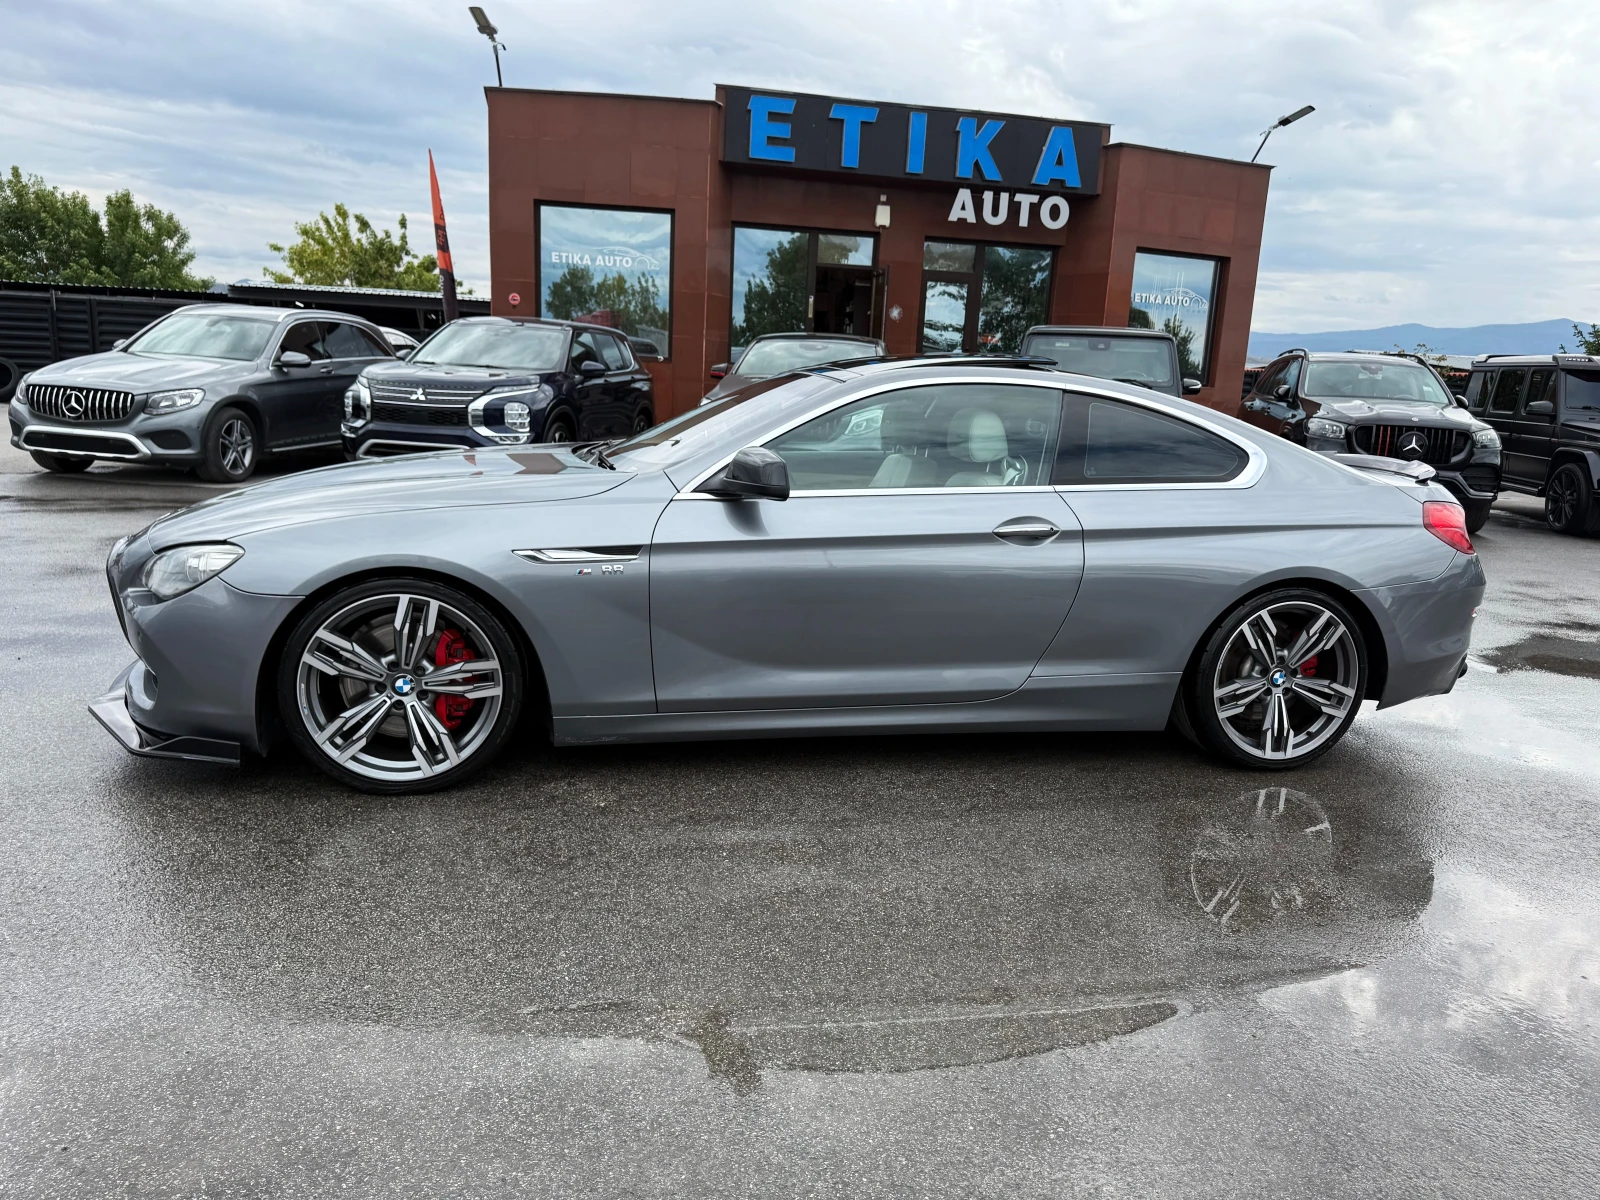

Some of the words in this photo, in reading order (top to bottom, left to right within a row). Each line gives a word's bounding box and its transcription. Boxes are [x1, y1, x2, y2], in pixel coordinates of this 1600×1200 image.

[747, 94, 1082, 188] ETIKA
[948, 188, 1070, 230] AUTO
[551, 251, 591, 265] ETIKA
[595, 255, 632, 268] AUTO
[1134, 293, 1162, 304] ETIKA
[1164, 295, 1190, 306] AUTO
